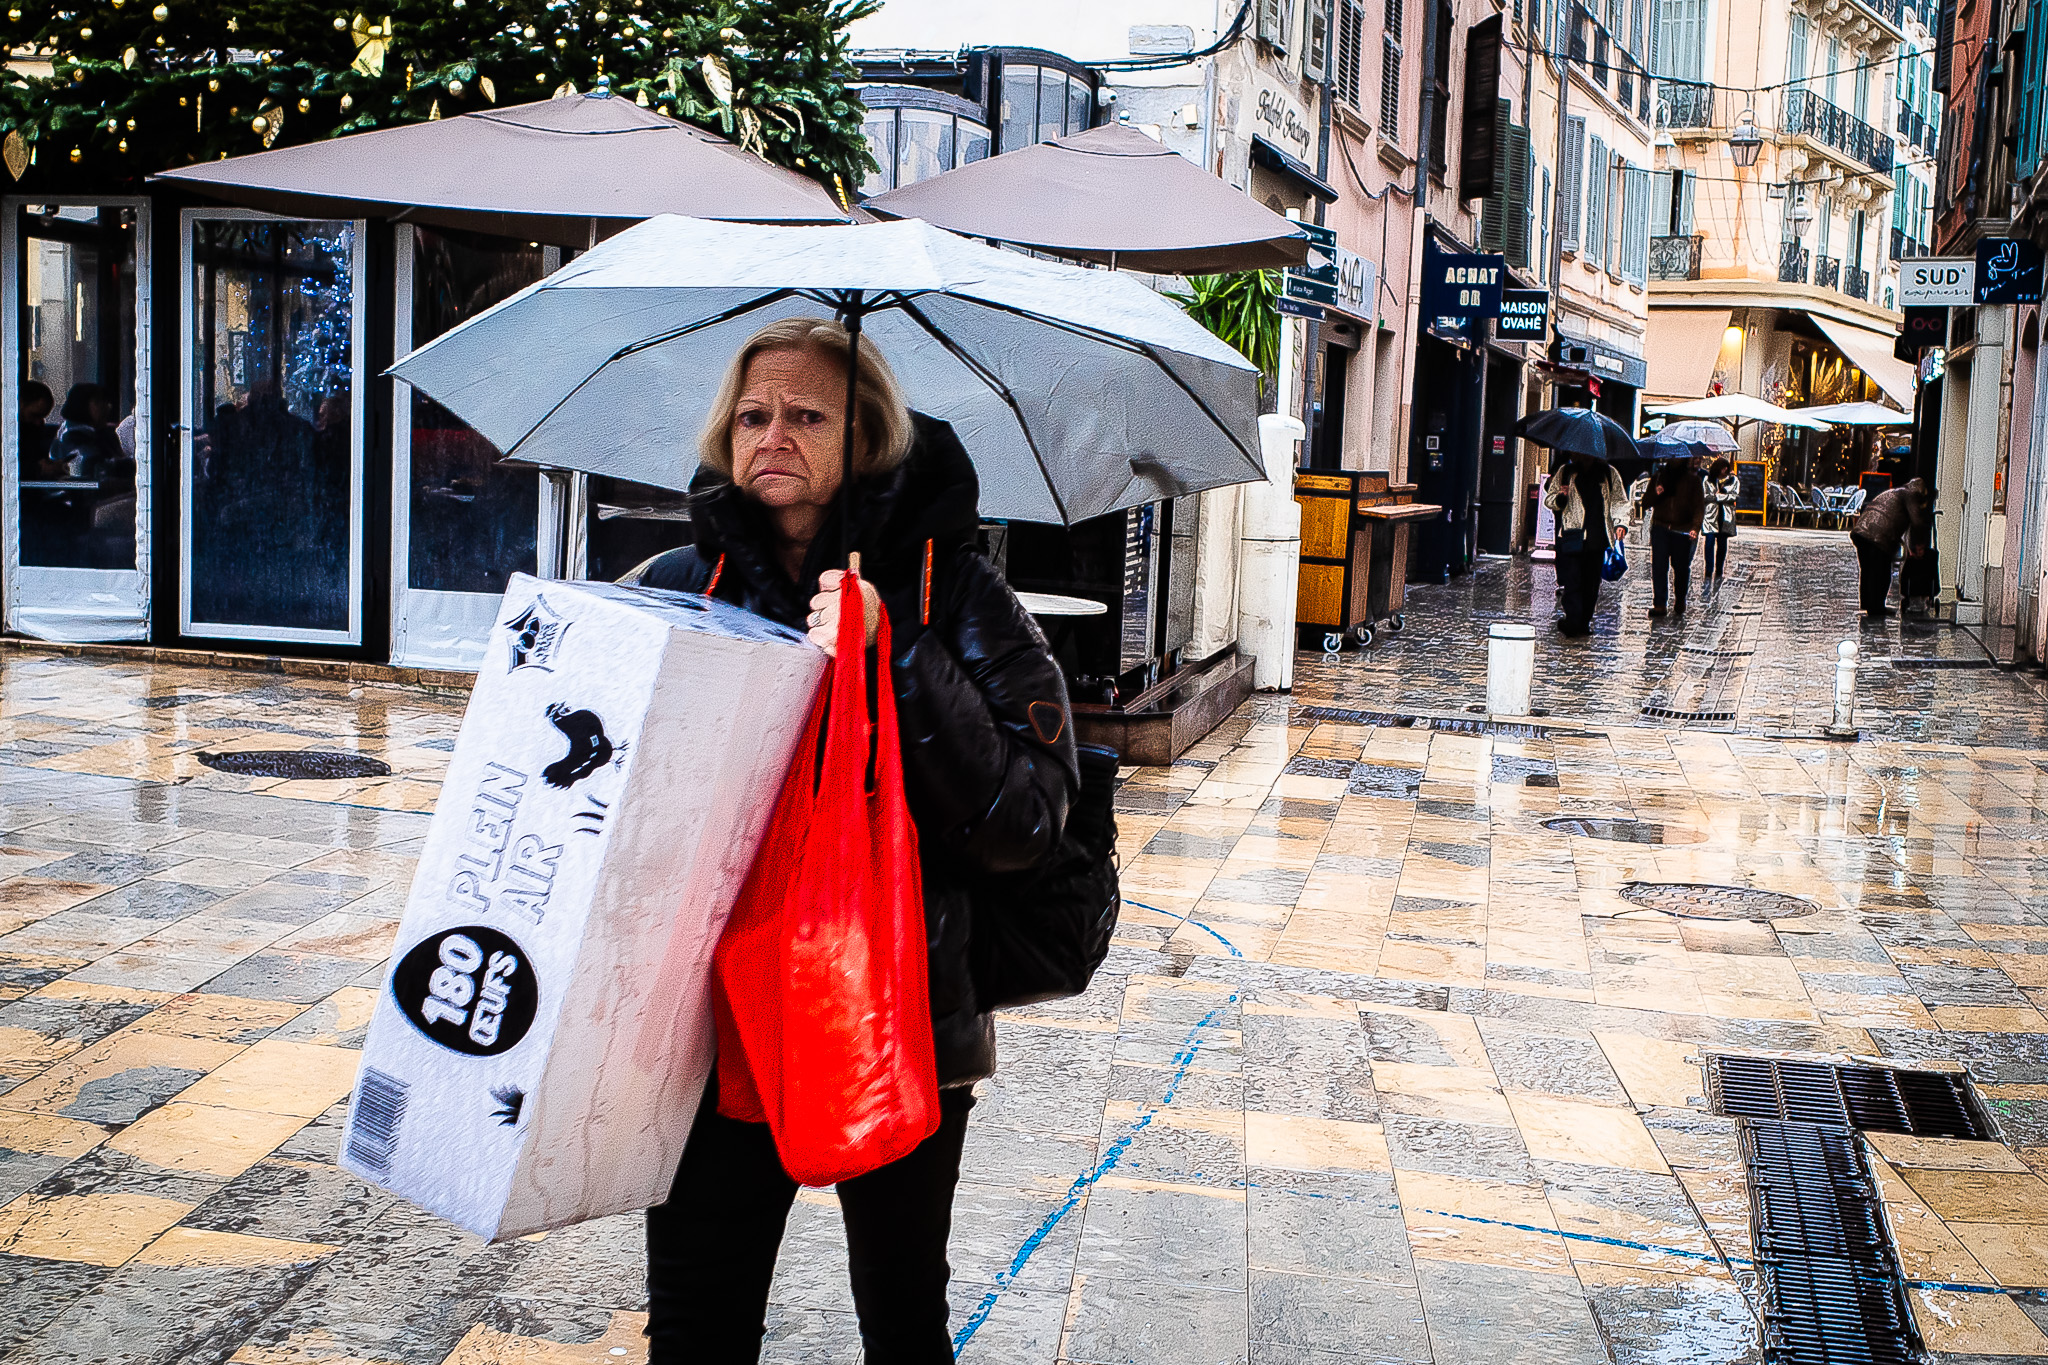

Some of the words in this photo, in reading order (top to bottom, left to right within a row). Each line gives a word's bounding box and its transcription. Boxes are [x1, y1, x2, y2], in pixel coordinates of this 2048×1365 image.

[1445, 267, 1498, 284] ACHAT
[1460, 290, 1481, 306] OR
[1500, 302, 1546, 315] MAISON
[1502, 316, 1541, 330] OVAHÊ
[446, 761, 529, 914] PLEIN
[500, 833, 565, 926] AIR
[421, 933, 483, 1027] 180
[468, 950, 519, 1047] ŒUFS
